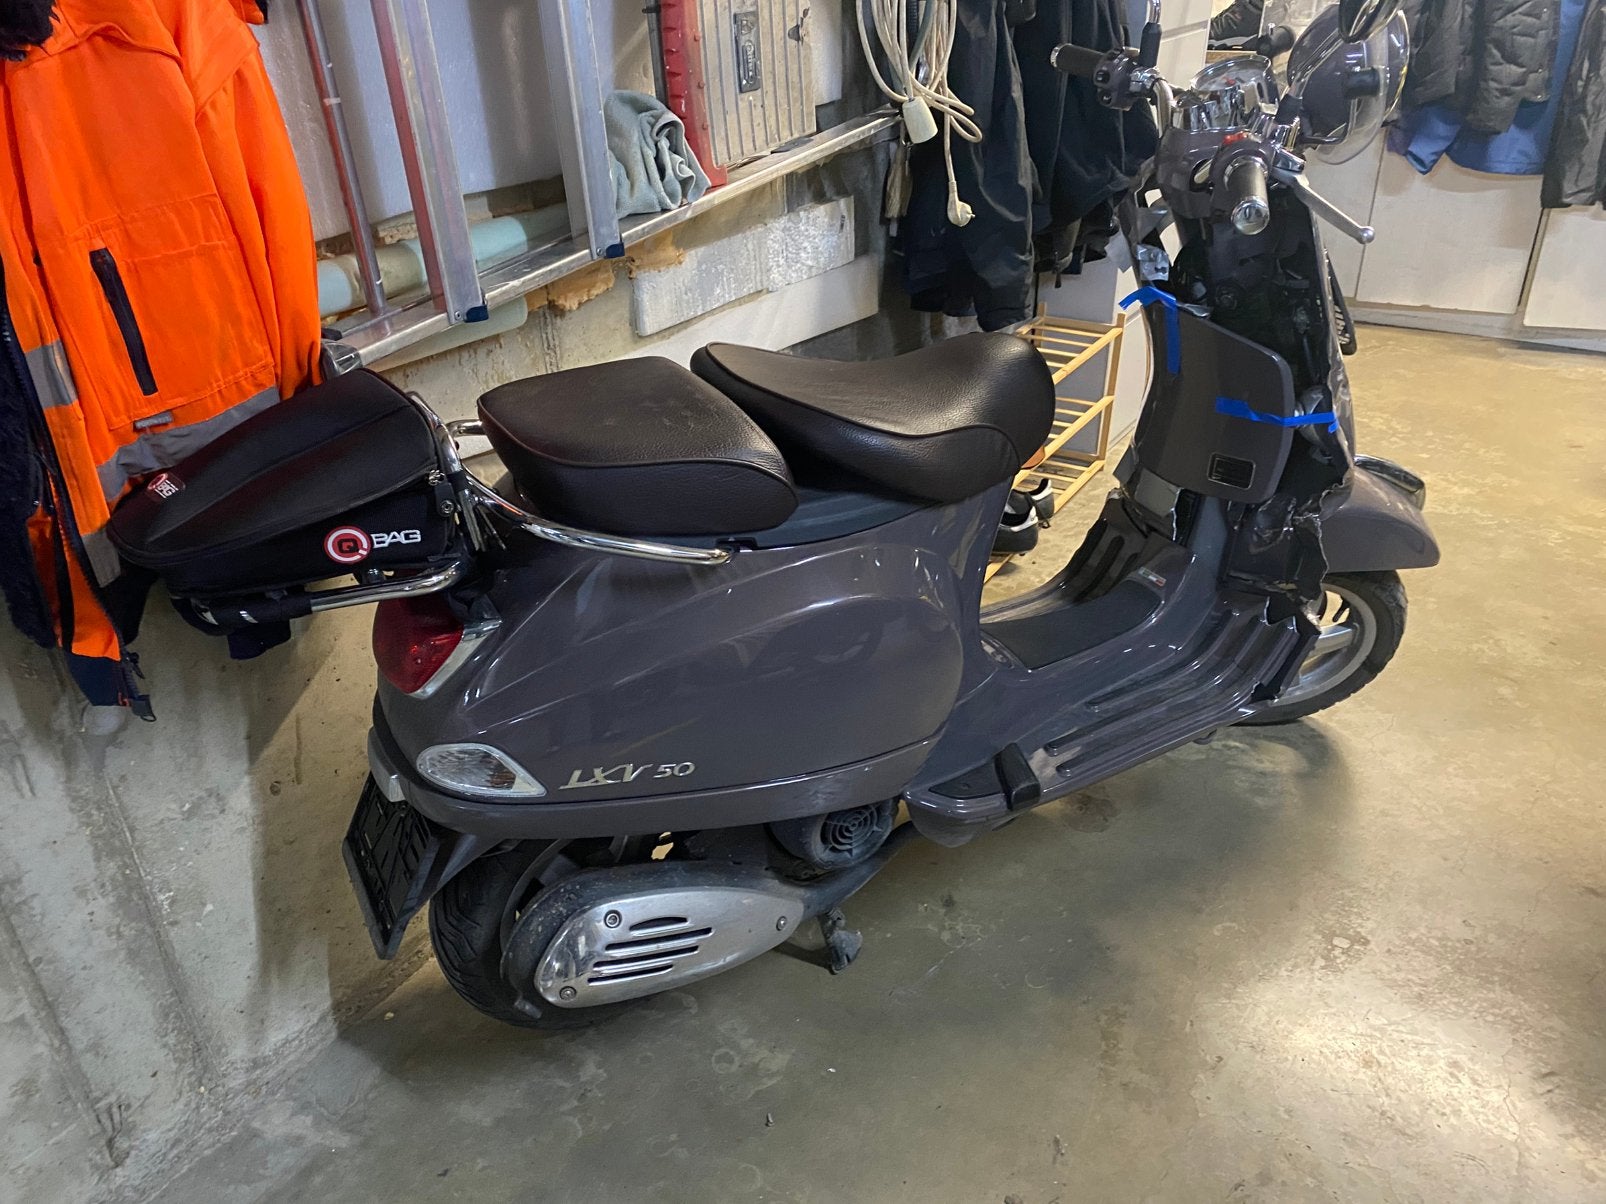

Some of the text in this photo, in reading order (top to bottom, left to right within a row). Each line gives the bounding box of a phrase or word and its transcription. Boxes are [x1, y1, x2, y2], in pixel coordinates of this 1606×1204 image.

[370, 529, 421, 549] BAG
[558, 761, 696, 790] LXV 50
